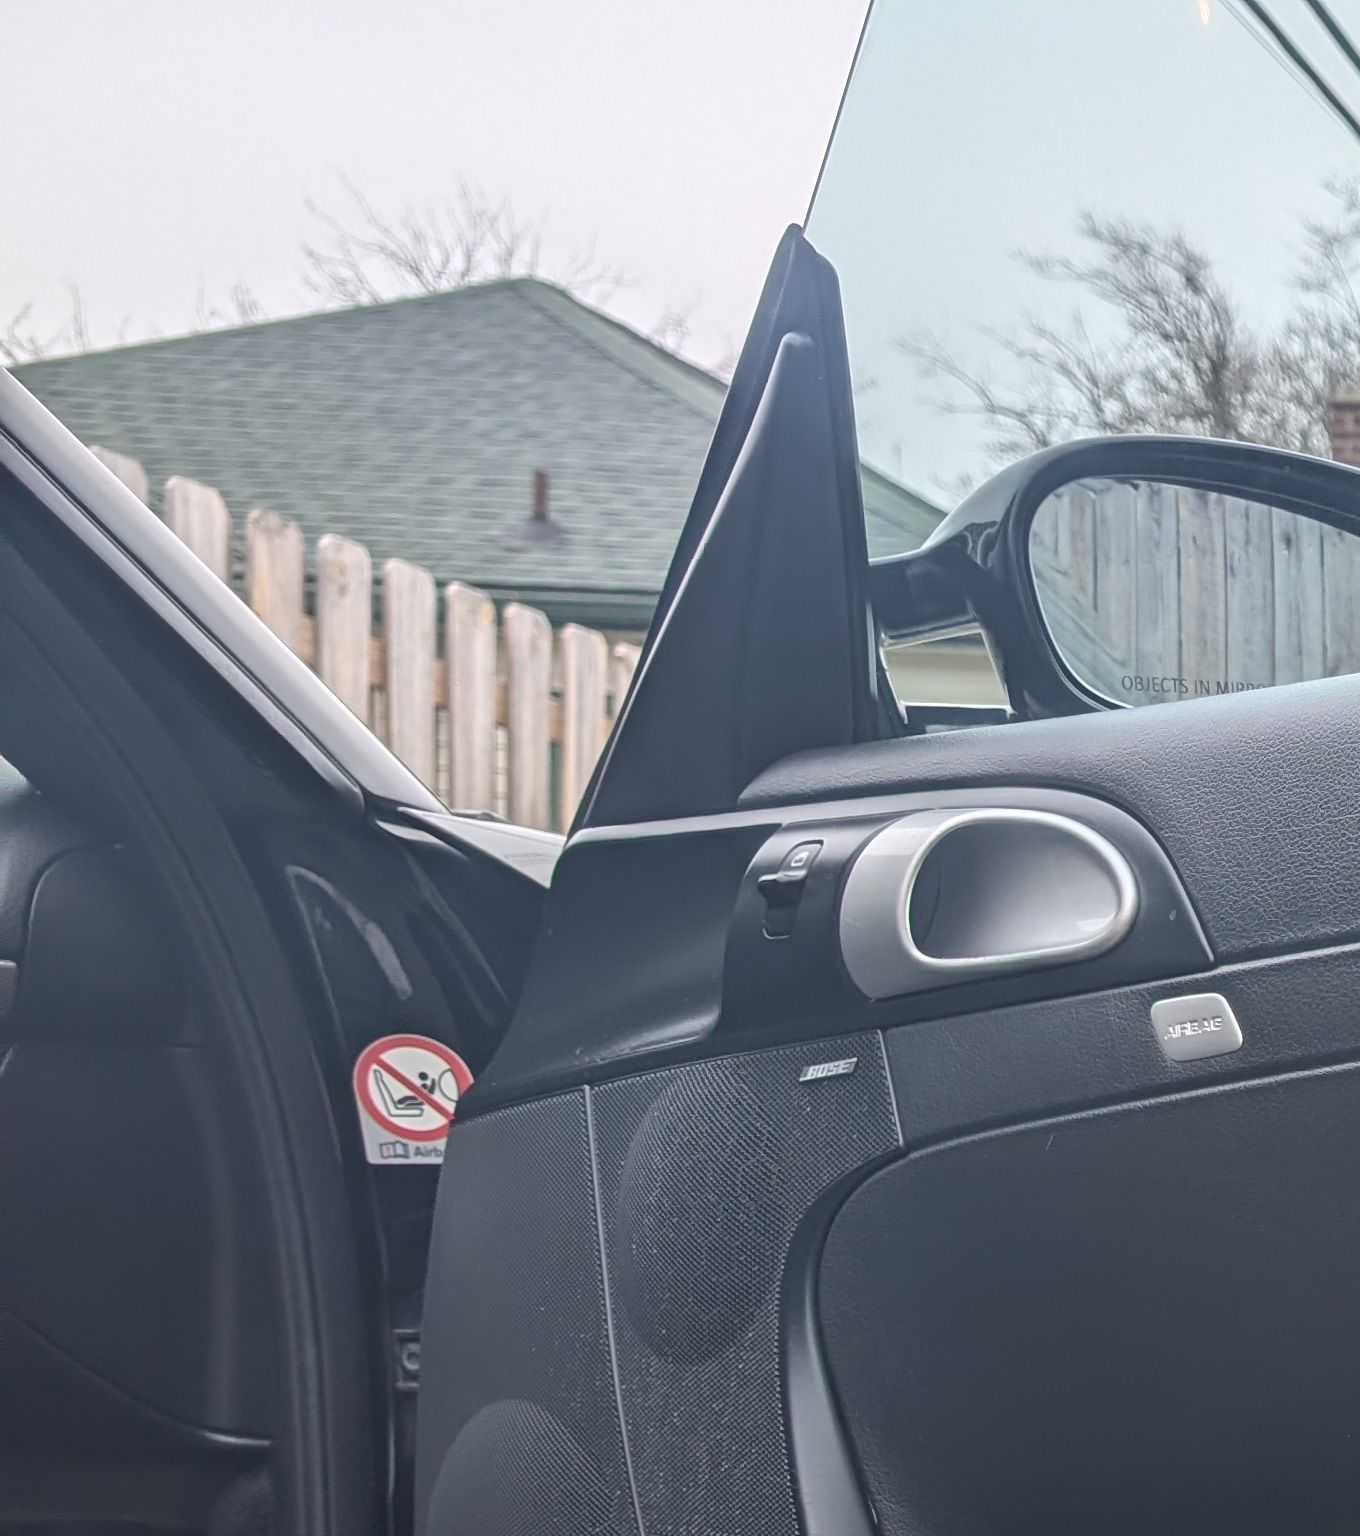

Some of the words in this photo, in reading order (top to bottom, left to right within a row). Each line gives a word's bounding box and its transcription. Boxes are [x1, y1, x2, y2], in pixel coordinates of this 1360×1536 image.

[1121, 675, 1188, 694] OBJECTS
[1194, 679, 1210, 695] IN
[1164, 1015, 1224, 1040] AIRBAG
[799, 1057, 858, 1082] BOSE
